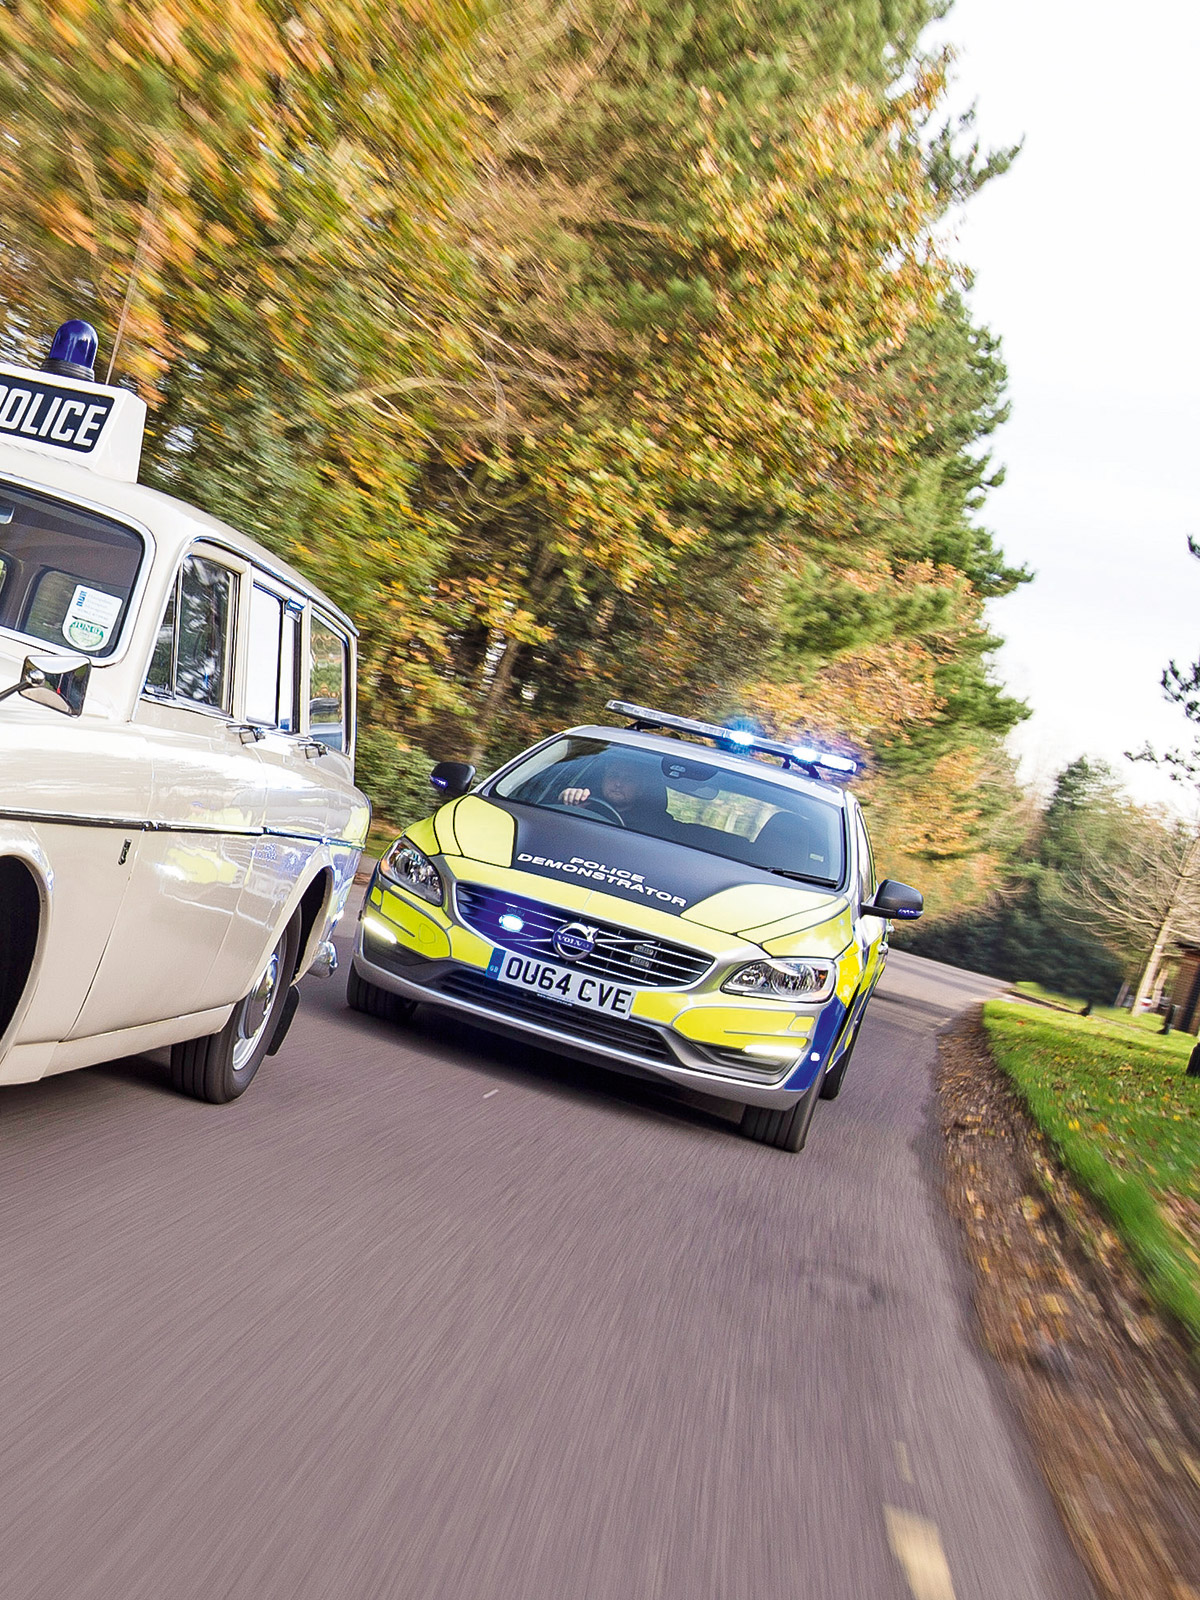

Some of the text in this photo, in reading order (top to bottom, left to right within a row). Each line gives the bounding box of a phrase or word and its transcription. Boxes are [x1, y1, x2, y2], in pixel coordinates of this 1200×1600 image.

[517, 853, 688, 907] DEMONSTRATOR
[570, 856, 646, 883] POLICE
[557, 934, 590, 949] VOLVO
[506, 956, 632, 1014] OU64 CVE
